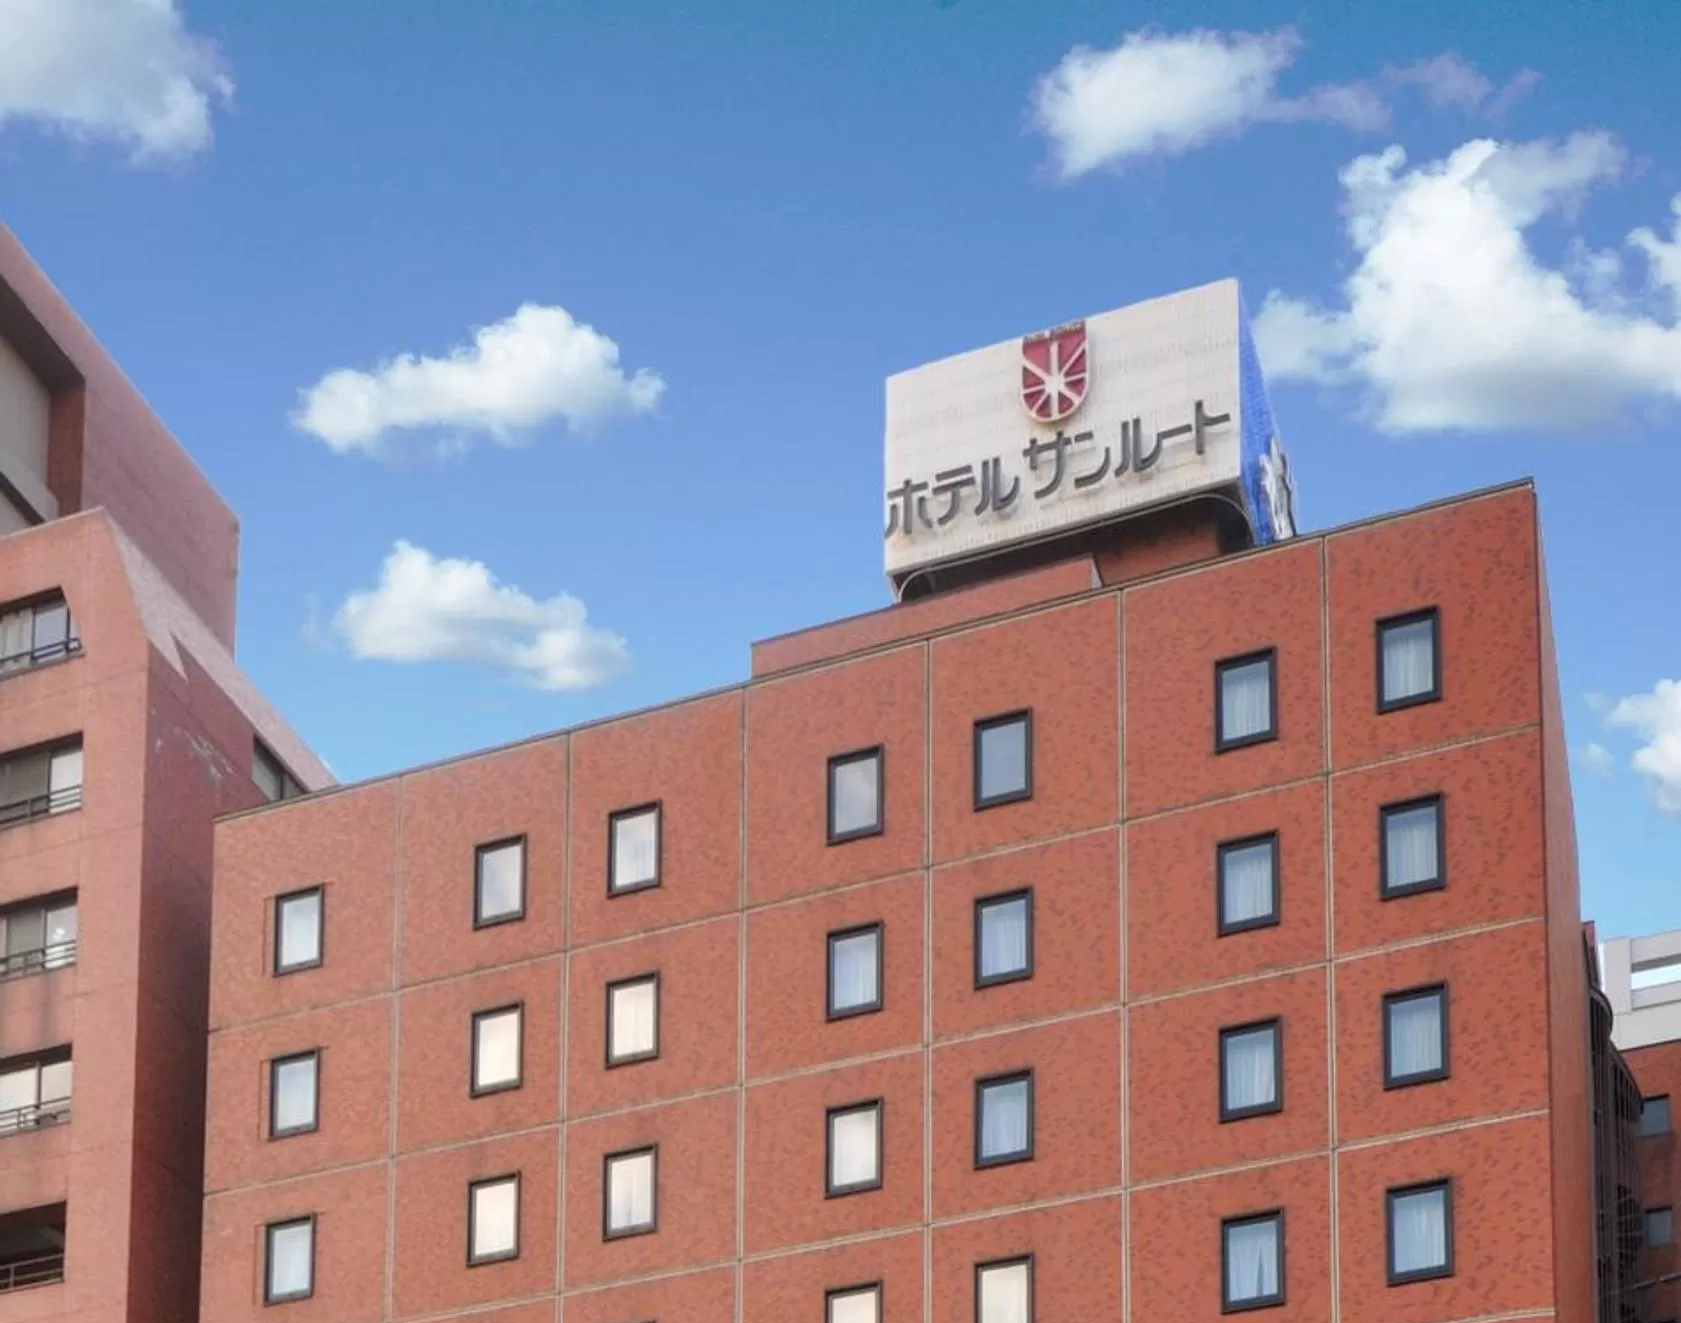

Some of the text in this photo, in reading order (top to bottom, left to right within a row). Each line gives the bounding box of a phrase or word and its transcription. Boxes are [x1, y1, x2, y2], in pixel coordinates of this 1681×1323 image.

[885, 399, 1231, 539] ホテル サンルート
